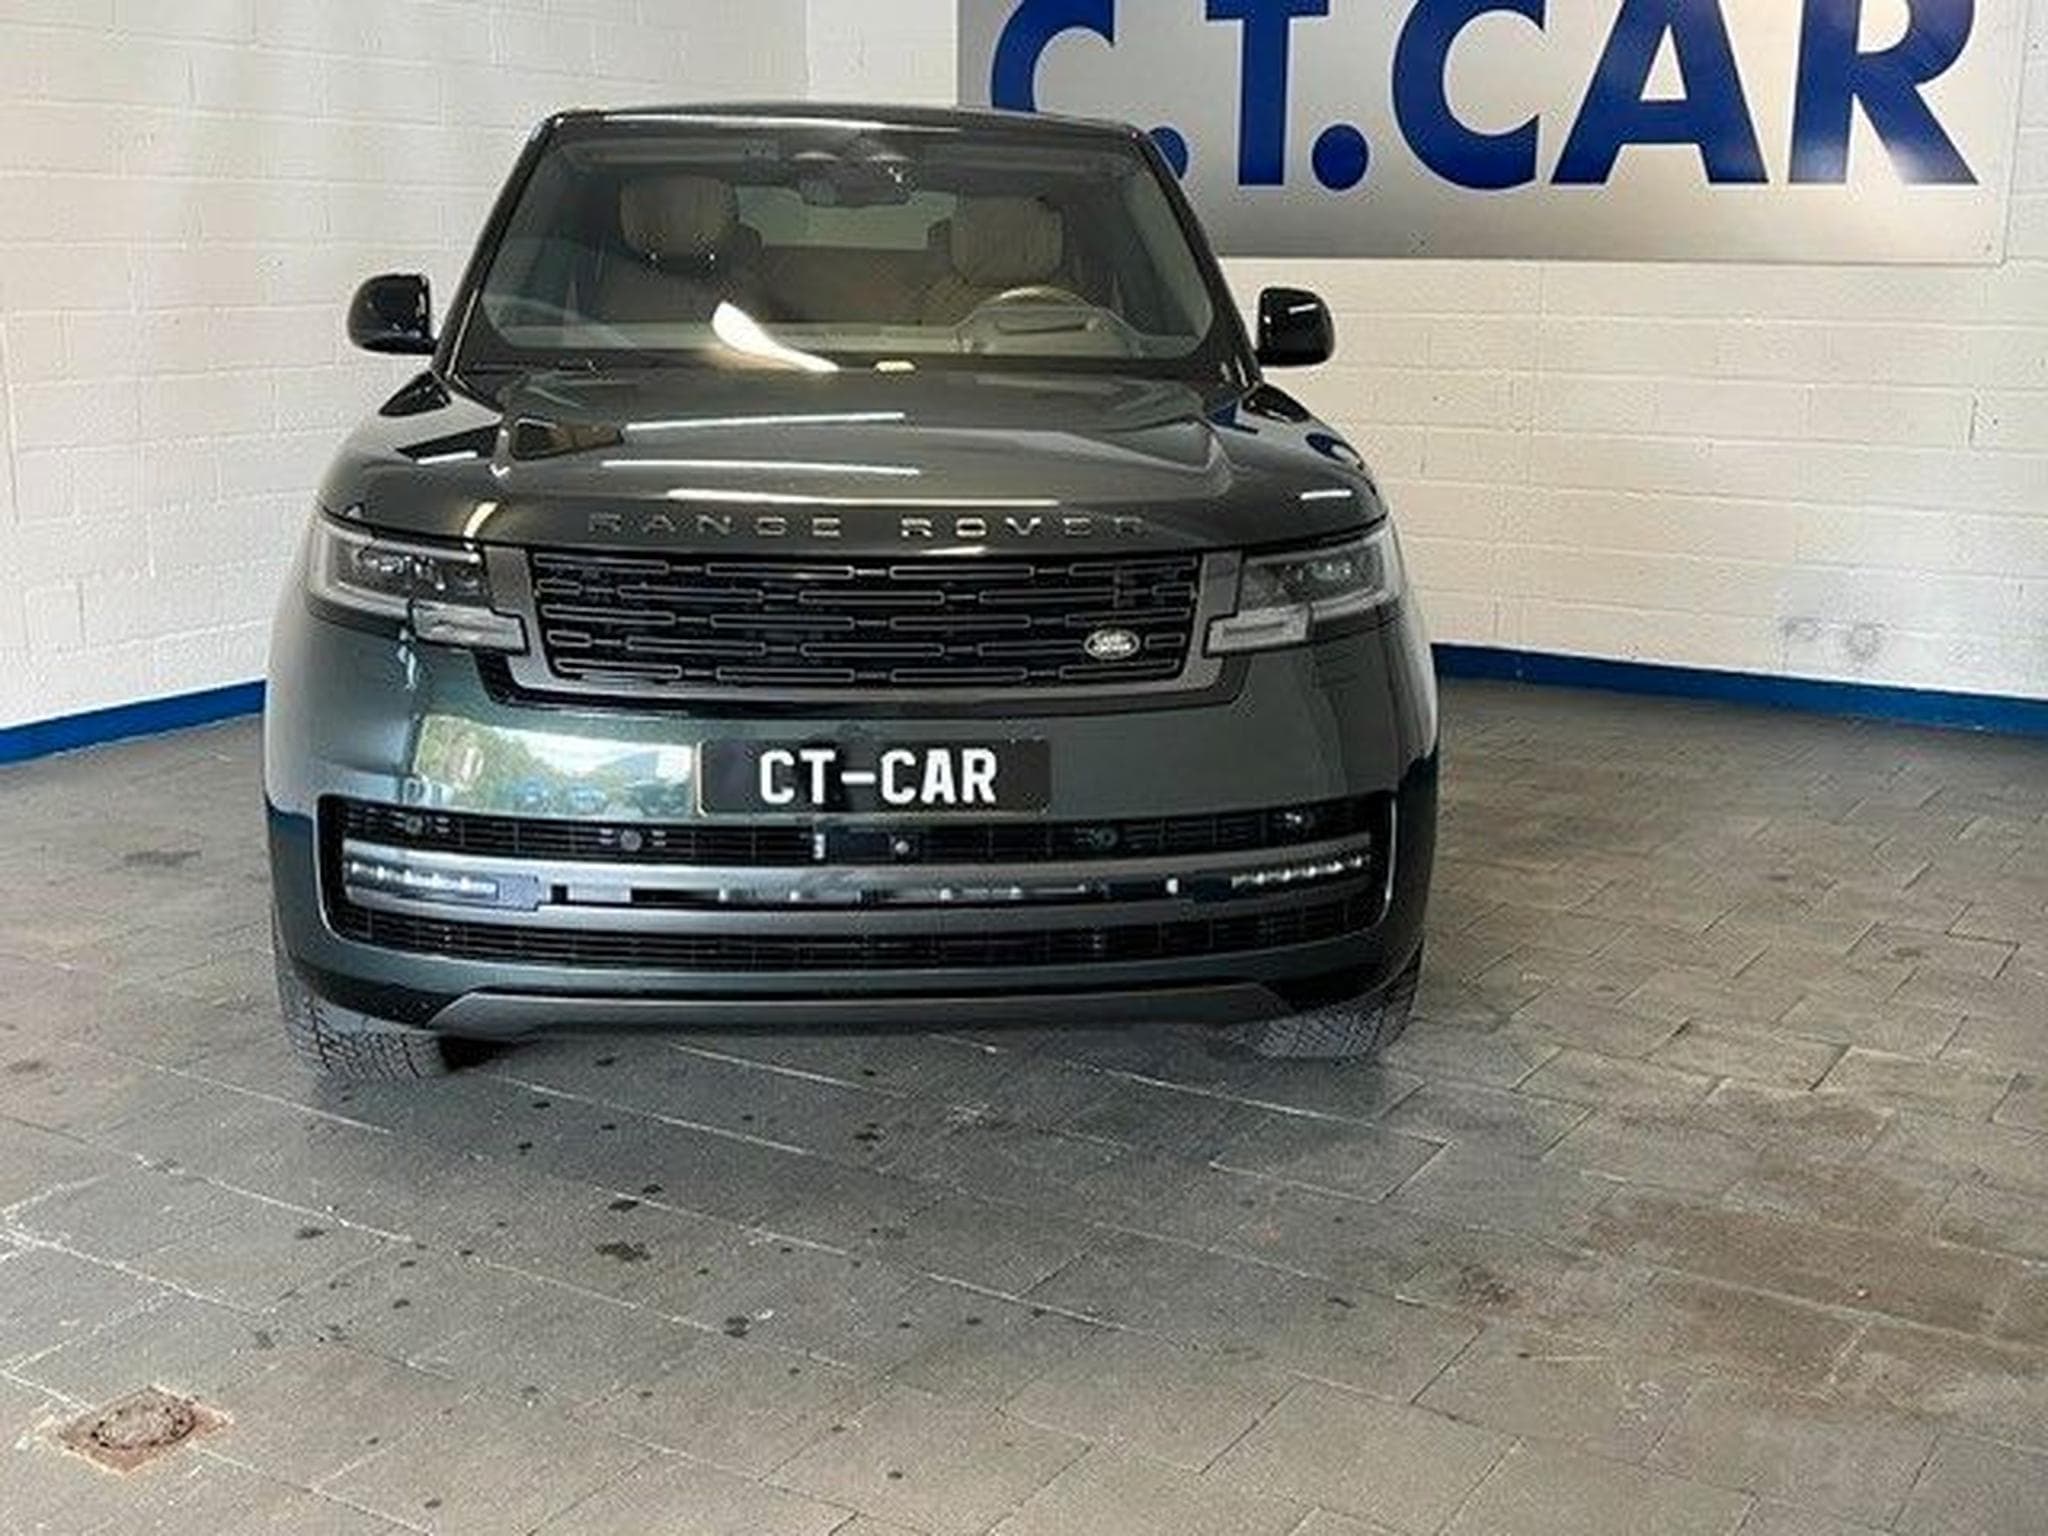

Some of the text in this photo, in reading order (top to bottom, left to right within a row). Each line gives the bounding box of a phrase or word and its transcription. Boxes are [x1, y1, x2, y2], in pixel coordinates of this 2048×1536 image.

[587, 512, 1149, 538] RANGE ROVER
[759, 748, 998, 805] CT-CAR
